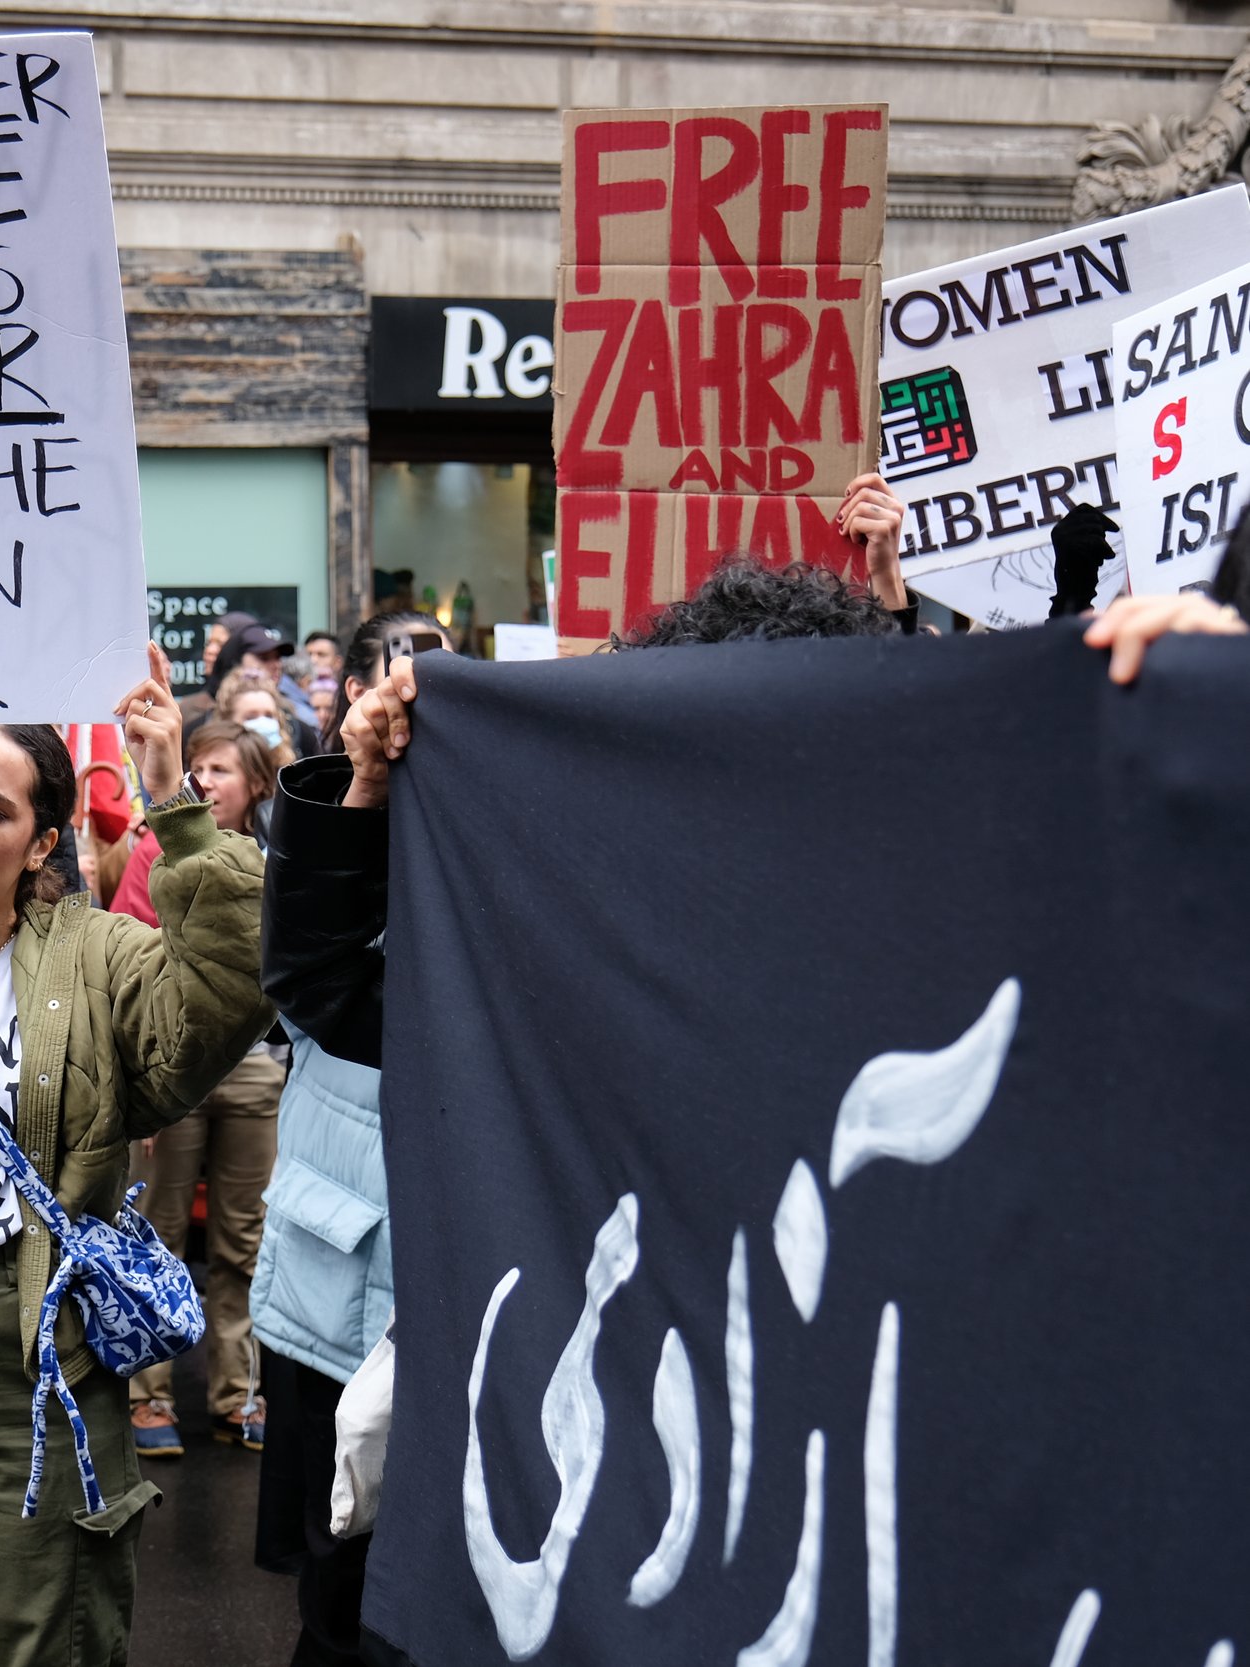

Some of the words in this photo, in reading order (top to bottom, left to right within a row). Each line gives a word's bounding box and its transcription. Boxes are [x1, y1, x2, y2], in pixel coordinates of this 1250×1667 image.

[575, 110, 882, 306] FREE
[880, 234, 1131, 357] OMEN
[437, 306, 554, 398] Re
[1038, 349, 1114, 420] LI
[1122, 283, 1250, 402] SAN
[555, 299, 864, 490] ZAHRA
[669, 447, 815, 493] AND
[147, 590, 228, 622] Space
[152, 624, 195, 649] for
